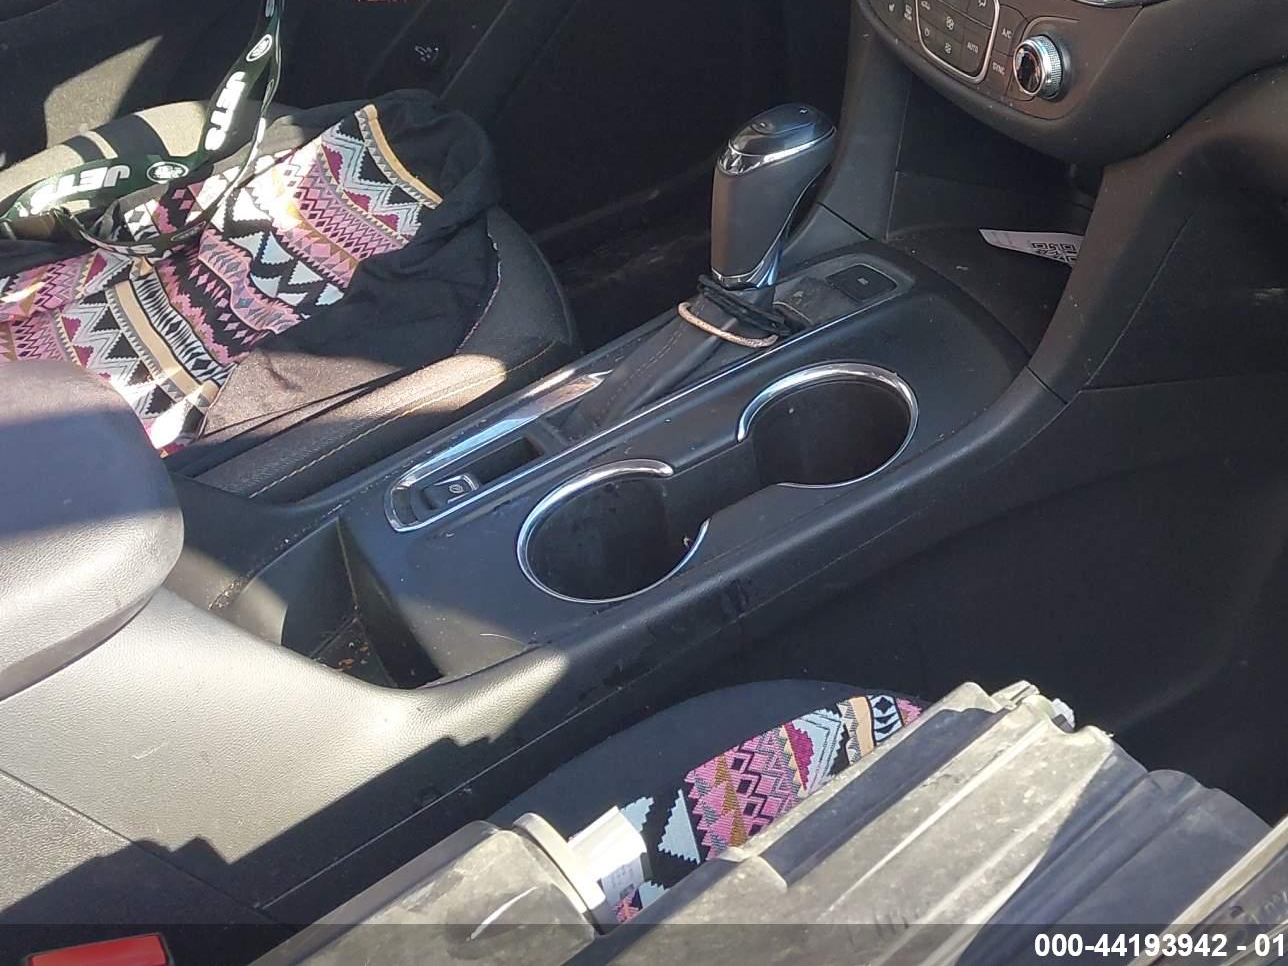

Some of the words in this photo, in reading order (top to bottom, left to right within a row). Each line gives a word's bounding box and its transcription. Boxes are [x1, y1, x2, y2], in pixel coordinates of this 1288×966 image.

[1002, 28, 1013, 40] A/C
[967, 41, 979, 54] AUTO
[204, 71, 246, 151] JETS
